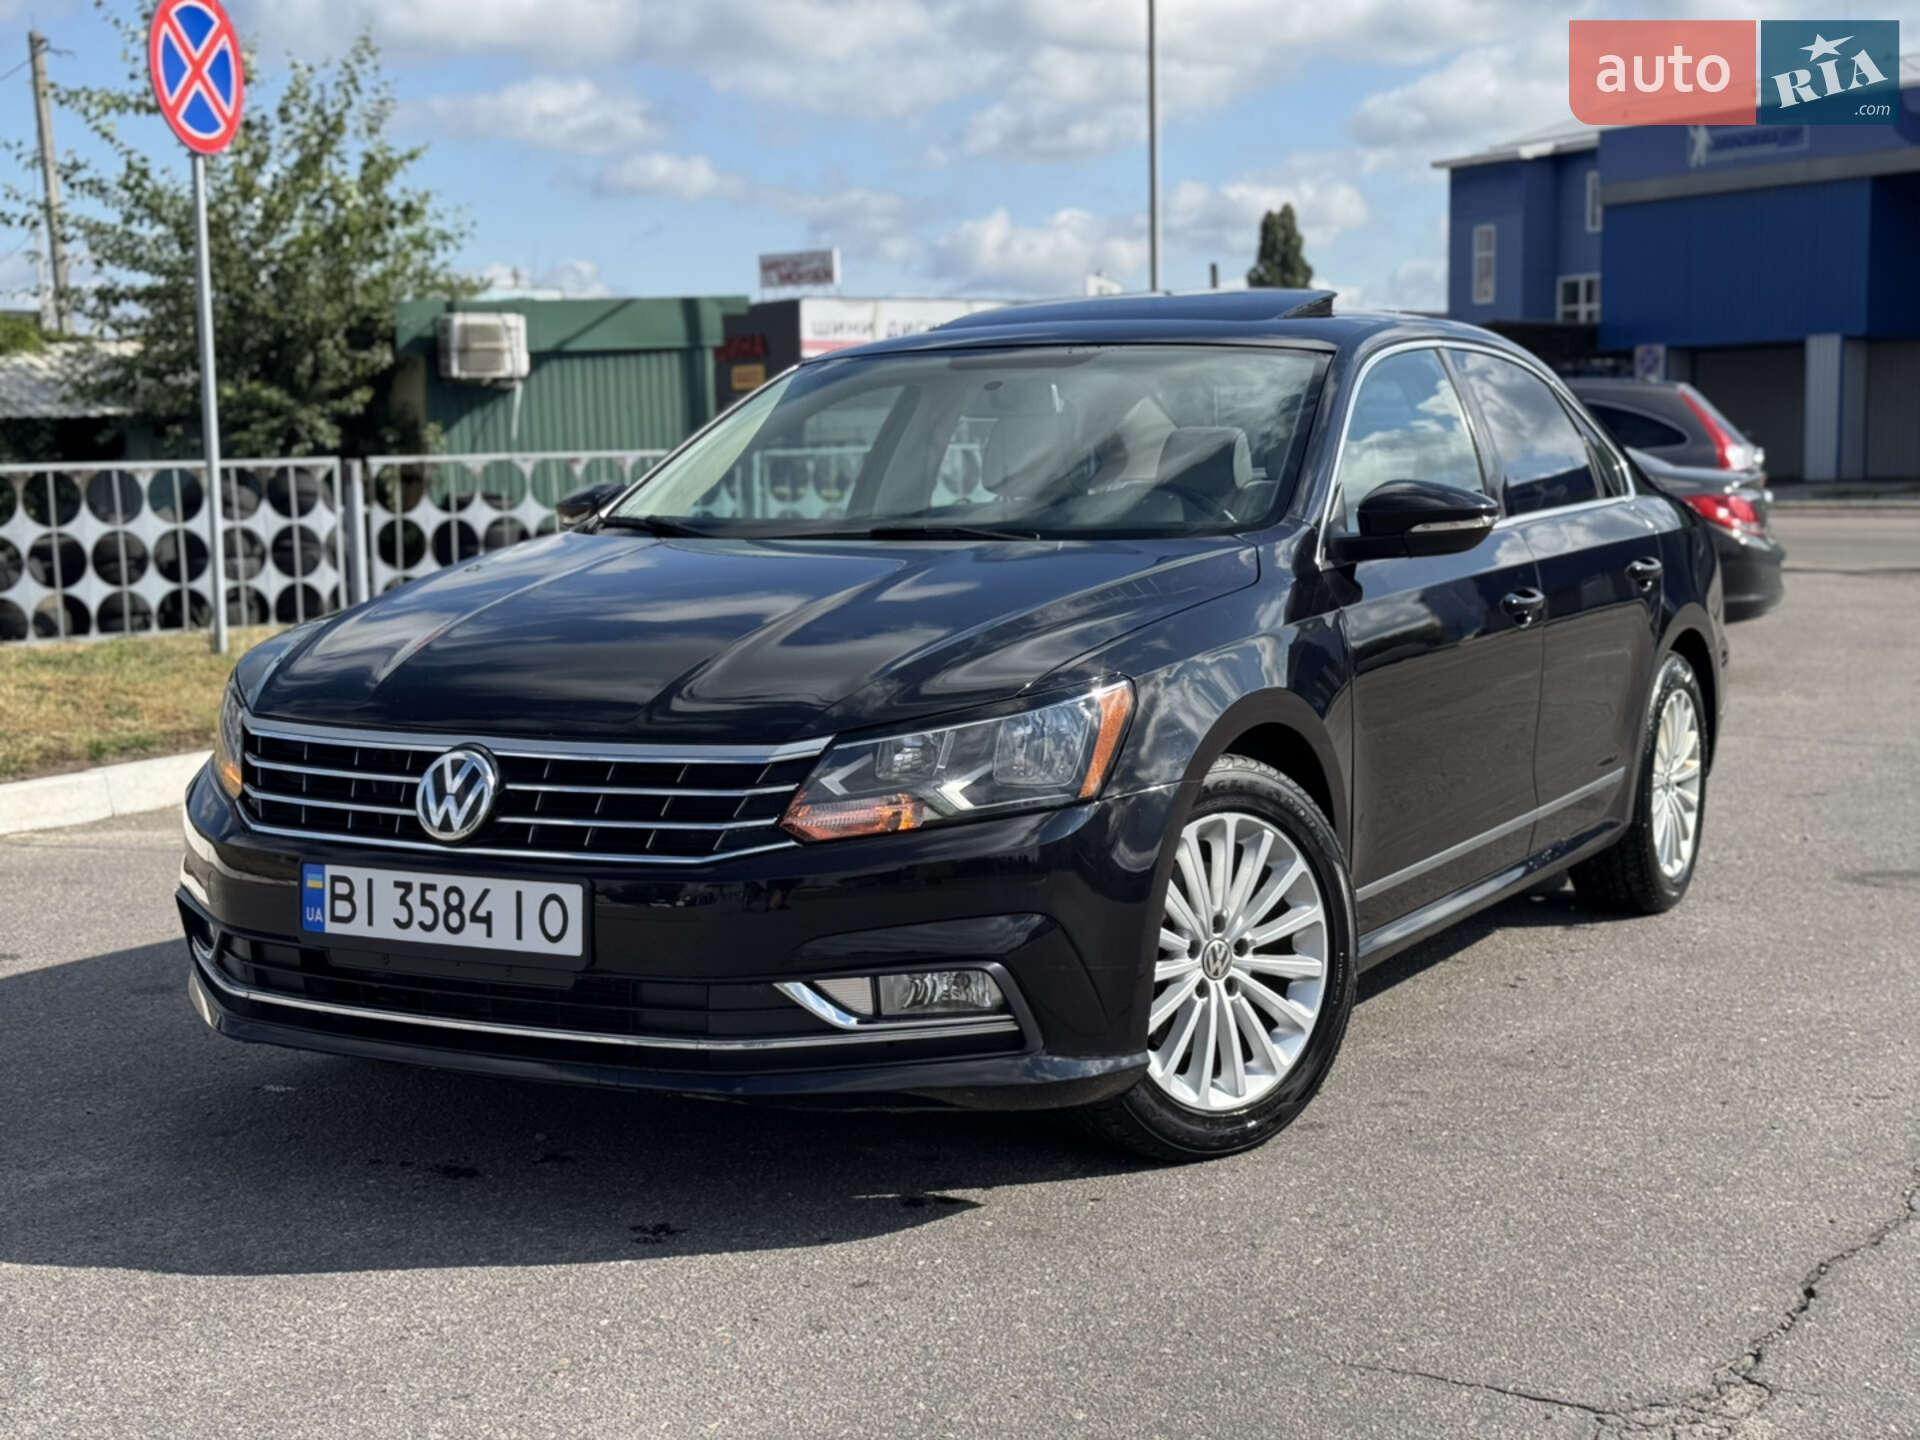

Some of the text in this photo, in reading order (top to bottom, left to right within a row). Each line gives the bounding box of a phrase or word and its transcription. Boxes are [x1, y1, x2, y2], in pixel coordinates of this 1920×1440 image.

[305, 906, 323, 923] UA
[329, 874, 569, 944] BI 3584 IO
